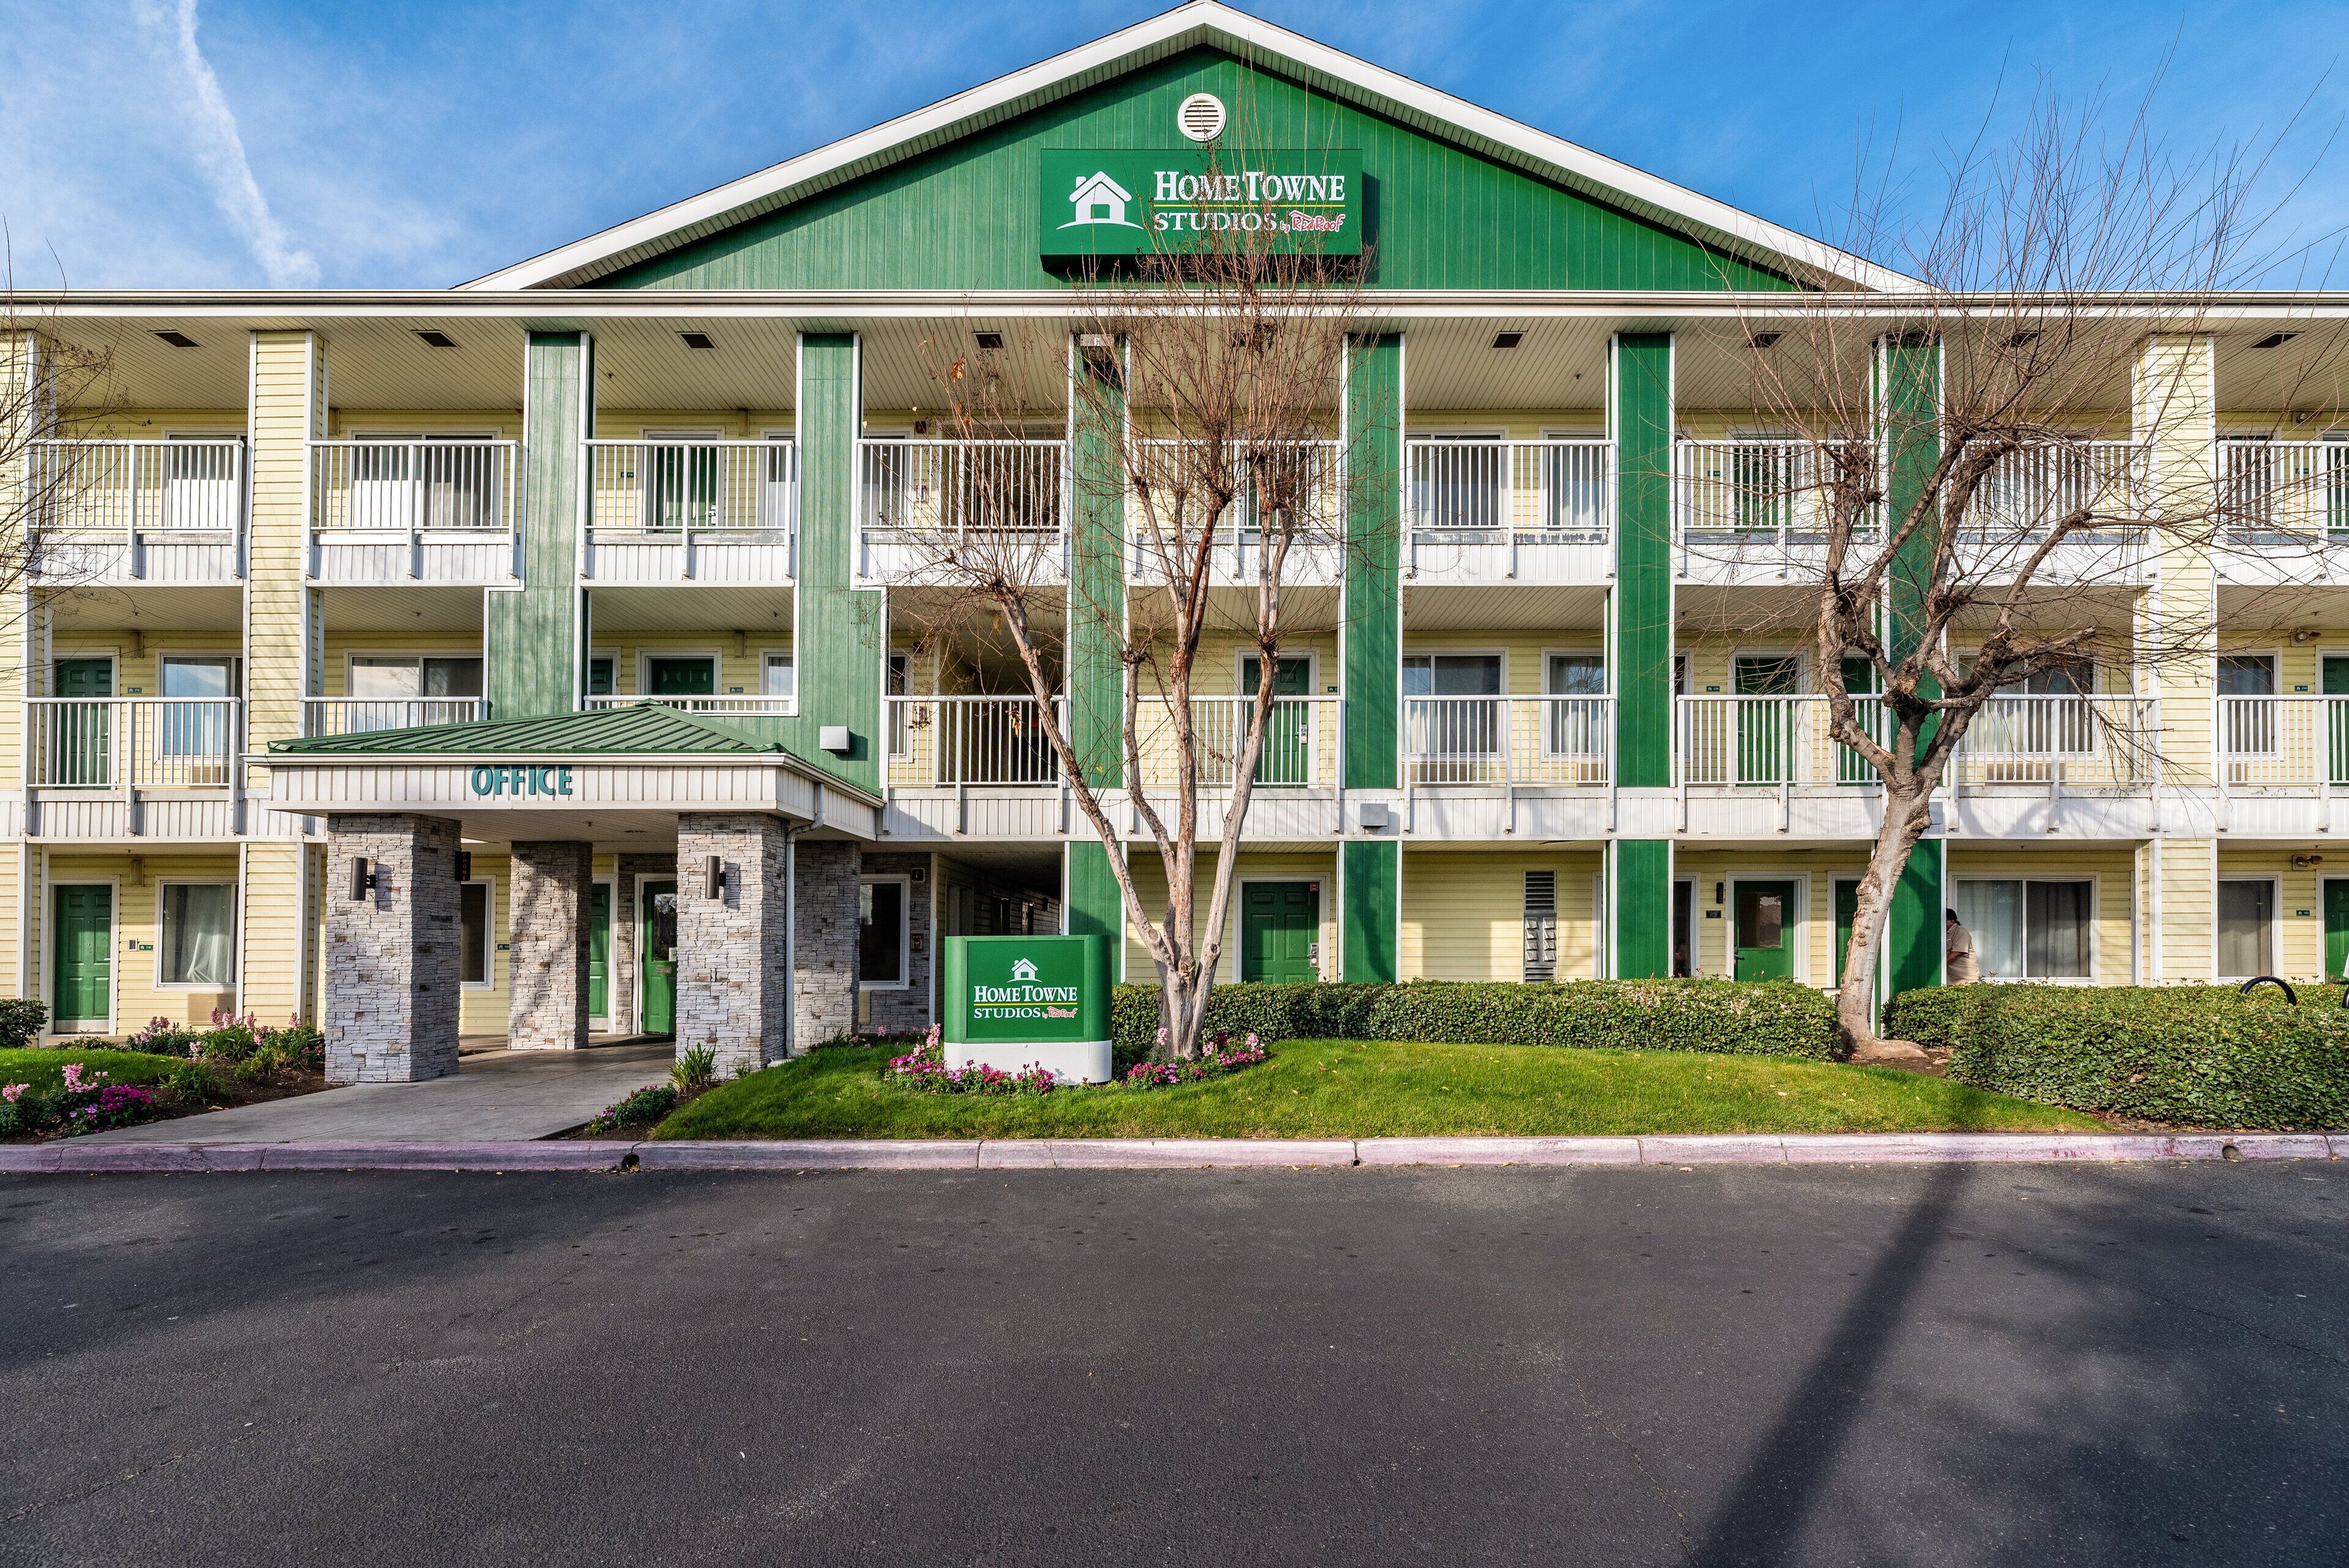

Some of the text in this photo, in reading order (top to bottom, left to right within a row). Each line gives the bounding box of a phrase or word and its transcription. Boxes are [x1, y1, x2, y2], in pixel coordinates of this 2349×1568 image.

[1154, 212, 1277, 231] STUDIOS
[1280, 220, 1290, 233] by
[1314, 214, 1346, 232] Roof
[471, 765, 573, 796] OFFICE
[974, 1007, 1041, 1018] STUDIOS
[1048, 1009, 1061, 1017] Red
[1061, 1008, 1078, 1018] Roof
